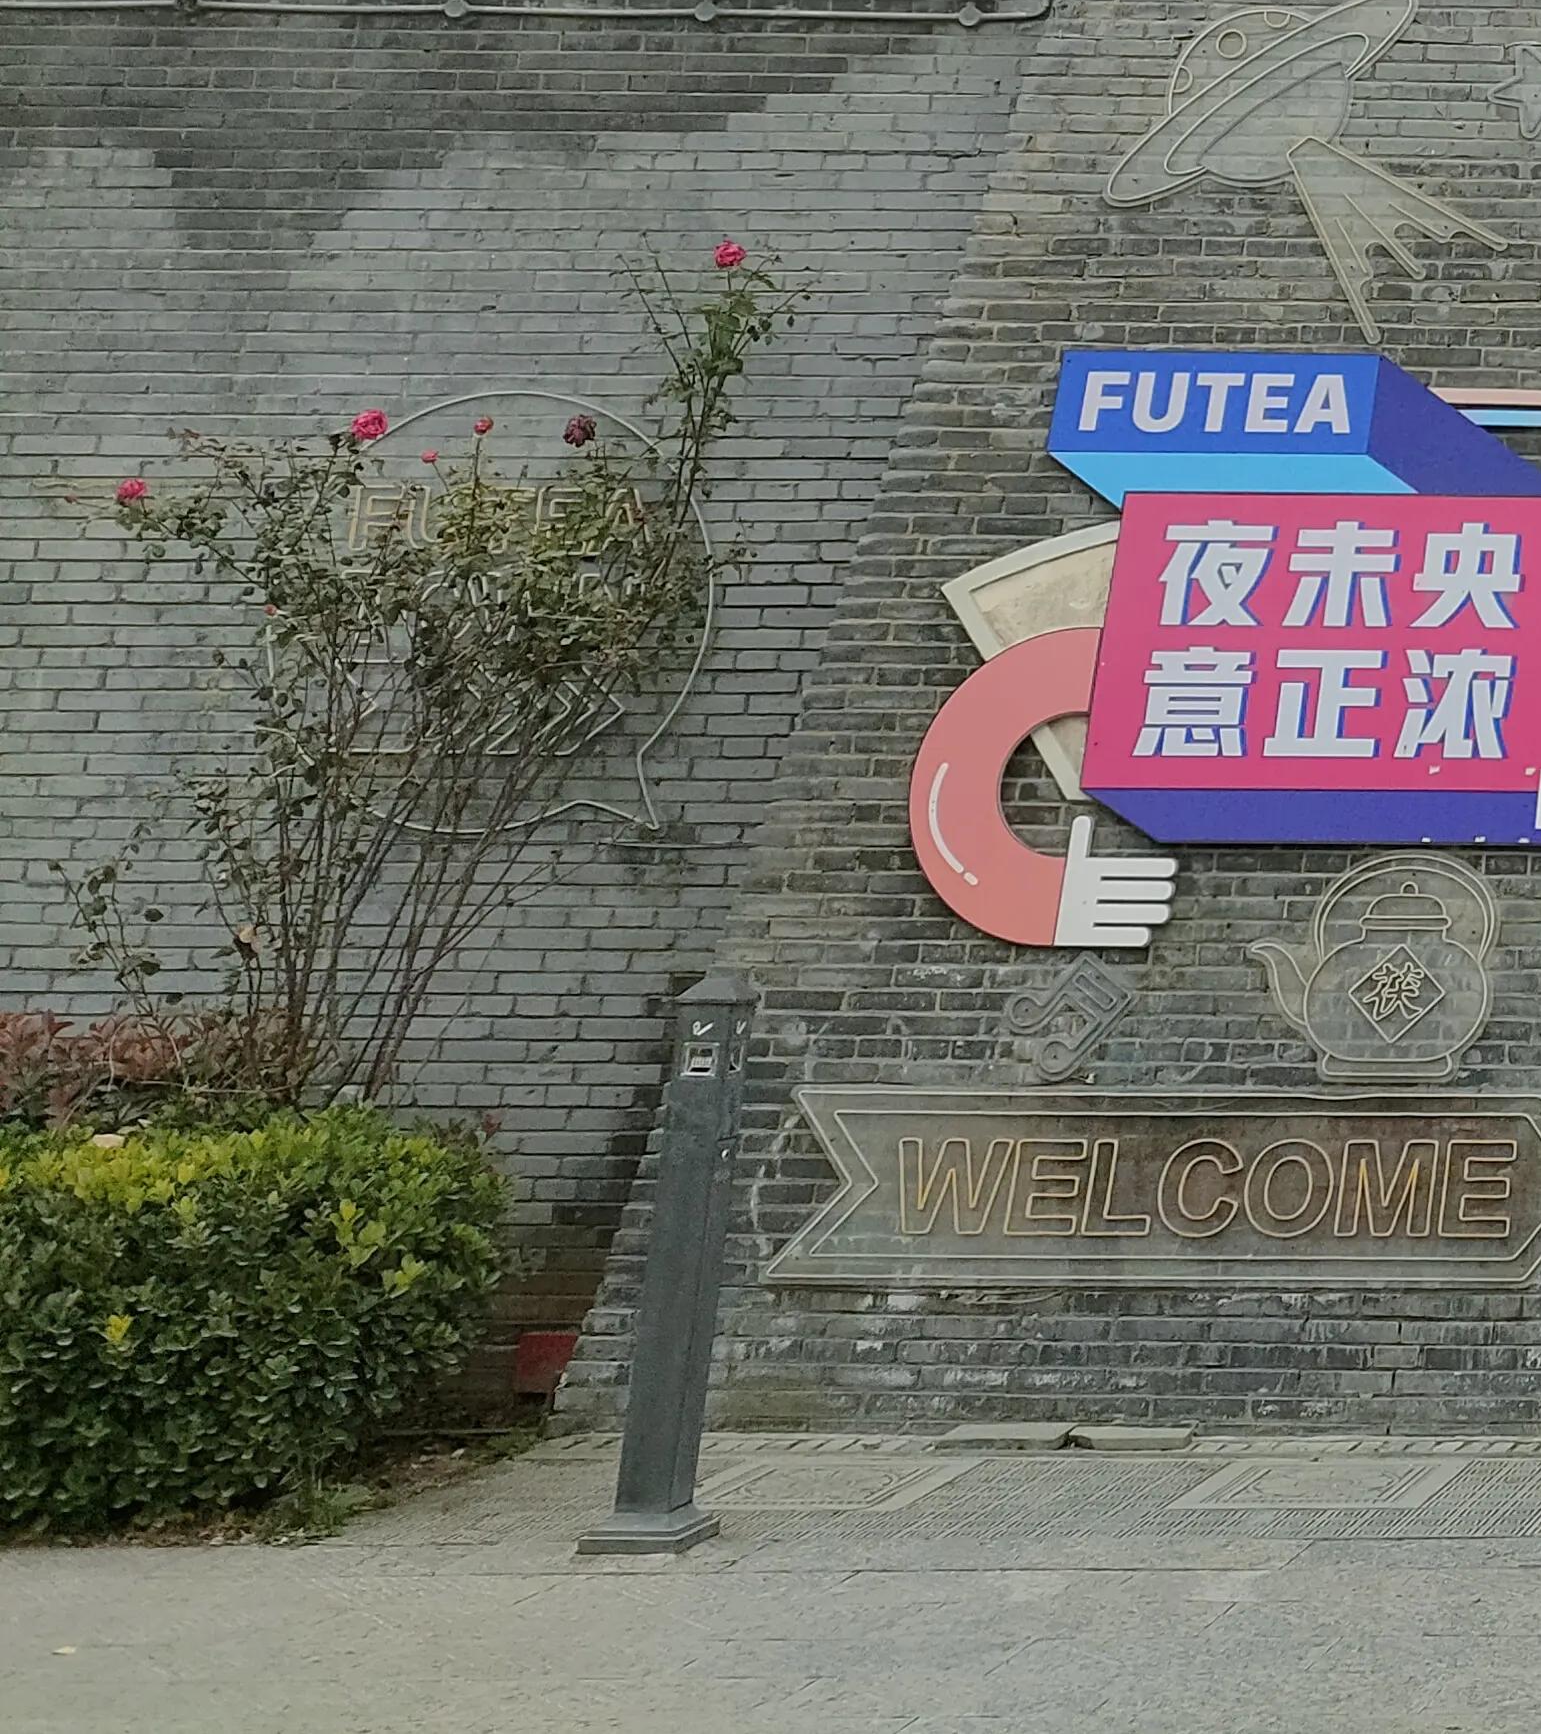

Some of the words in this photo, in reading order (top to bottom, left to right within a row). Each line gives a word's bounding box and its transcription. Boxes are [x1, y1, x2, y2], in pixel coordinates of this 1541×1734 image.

[1077, 371, 1351, 434] FUTEA
[1158, 520, 1524, 629] 夜未央
[1131, 646, 1514, 759] 意正浓
[897, 1136, 1518, 1240] WELCOME
